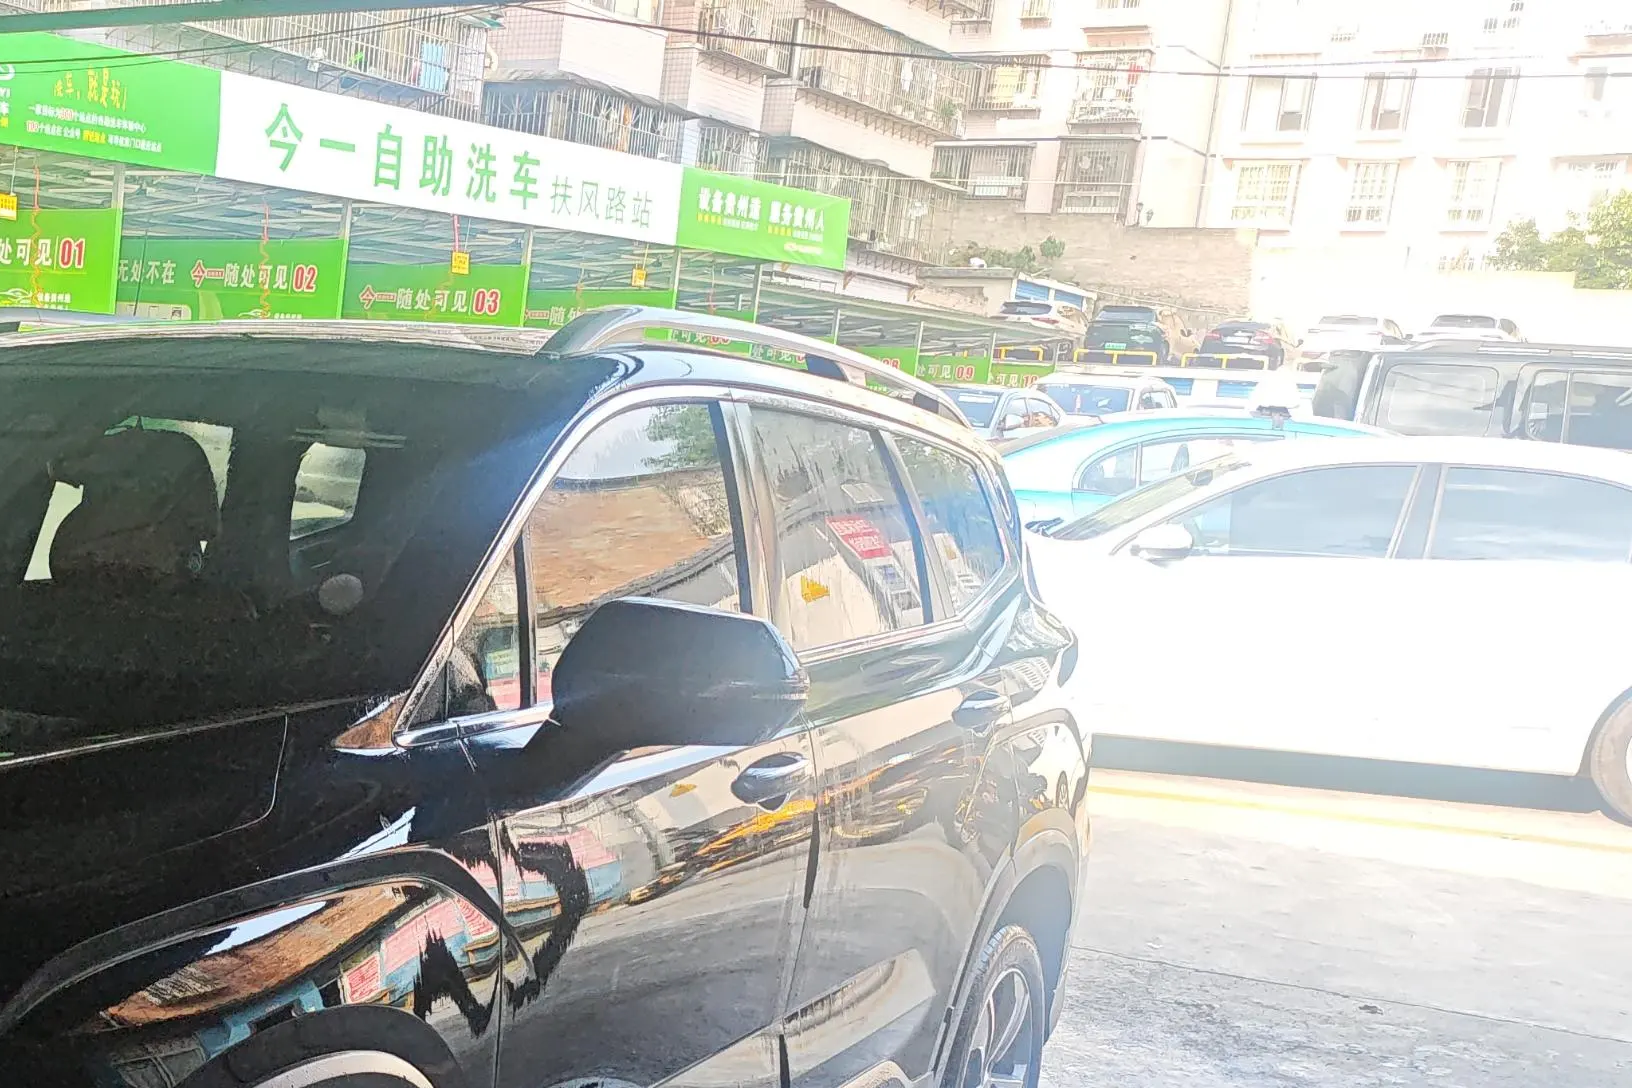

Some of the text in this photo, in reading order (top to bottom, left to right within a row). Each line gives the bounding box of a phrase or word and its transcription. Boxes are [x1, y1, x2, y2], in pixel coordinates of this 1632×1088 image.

[265, 102, 653, 229] 今一自助洗车 扶风路站
[58, 238, 85, 269] 01
[292, 264, 318, 292] 02
[472, 288, 500, 316] 03
[954, 364, 976, 381] 09
